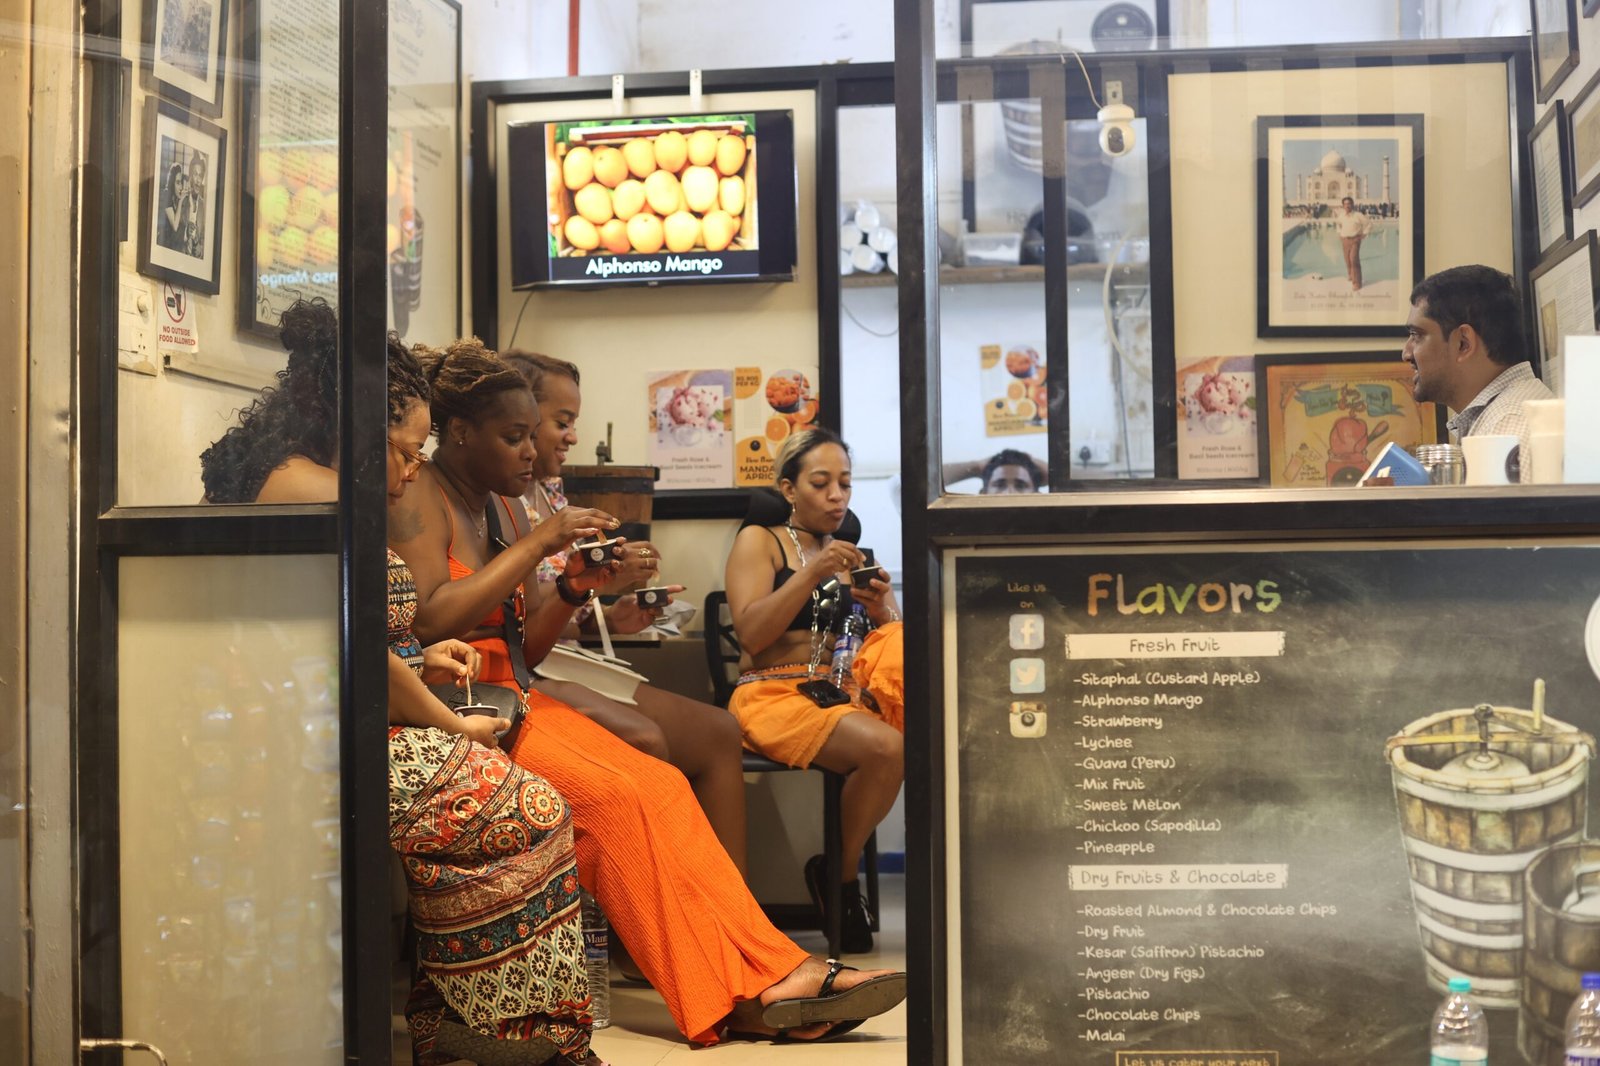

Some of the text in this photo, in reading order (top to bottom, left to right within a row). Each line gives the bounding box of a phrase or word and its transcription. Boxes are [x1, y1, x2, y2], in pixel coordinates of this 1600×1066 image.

[586, 256, 723, 278] Alphonso Mango
[171, 327, 191, 337] OUTSIDE
[159, 334, 196, 346] FOOD ALLOWED
[1007, 583, 1031, 593] Like
[1087, 573, 1282, 616] Flavors
[1129, 637, 1221, 653] Fresh Fruit
[1073, 671, 1261, 688] -Sitaphal (Custard Apple)
[1074, 694, 1204, 709] -Alphonso Mango
[1074, 715, 1164, 730] -Strawberry
[1074, 736, 1134, 751] -Lychee
[1075, 756, 1176, 769] -Guava (Peru)
[1075, 778, 1146, 791] -Mix Fruit
[1075, 799, 1182, 812] -Sweet Melon
[1076, 818, 1223, 834] -Chickoo (Sapodilla)
[1076, 840, 1156, 856] -Pineapple
[1081, 869, 1277, 887] Dry Fruits & Chocolate
[1147, 904, 1203, 917] Almond
[1206, 904, 1217, 916] &
[1221, 903, 1295, 916] Chocolate
[1299, 903, 1338, 918] Chips
[1076, 925, 1146, 940] -Dry Fruit
[1077, 945, 1265, 960] -Kesar (Saffron) Pistachio
[1140, 967, 1170, 982] (Dry
[1173, 967, 1206, 983] Figs)
[1077, 987, 1151, 1001] -Pistachio
[1078, 1008, 1201, 1024] -Chocolate Chips
[1078, 1029, 1126, 1042] -Malai
